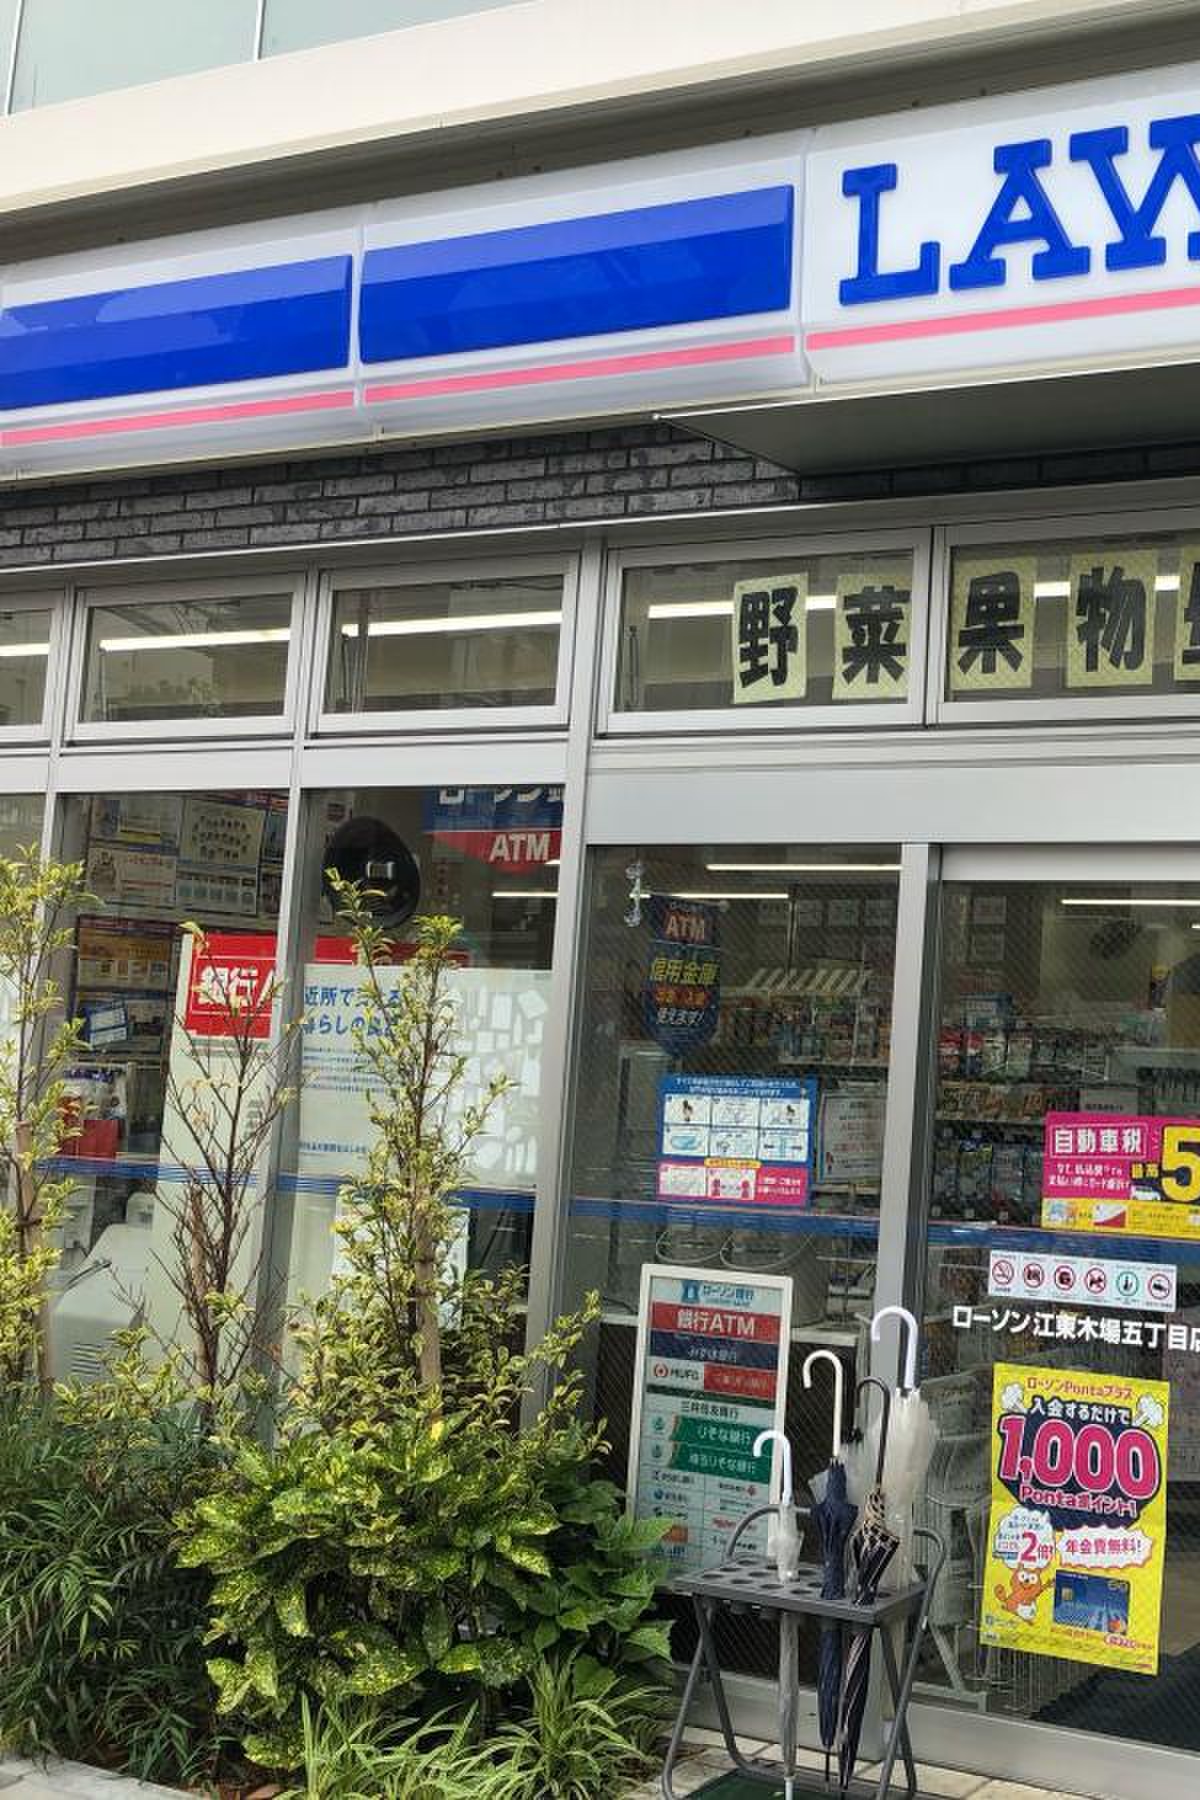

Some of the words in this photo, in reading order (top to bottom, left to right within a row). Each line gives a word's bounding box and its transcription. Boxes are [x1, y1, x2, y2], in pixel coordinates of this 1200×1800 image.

[489, 832, 550, 864] ATM
[665, 912, 705, 941] ATM
[1055, 1127, 1142, 1153] 自動車税
[677, 1308, 755, 1337] 銀行ATM
[1031, 1397, 1132, 1425] 入会するだけで
[999, 1414, 1160, 1500] 1,000
